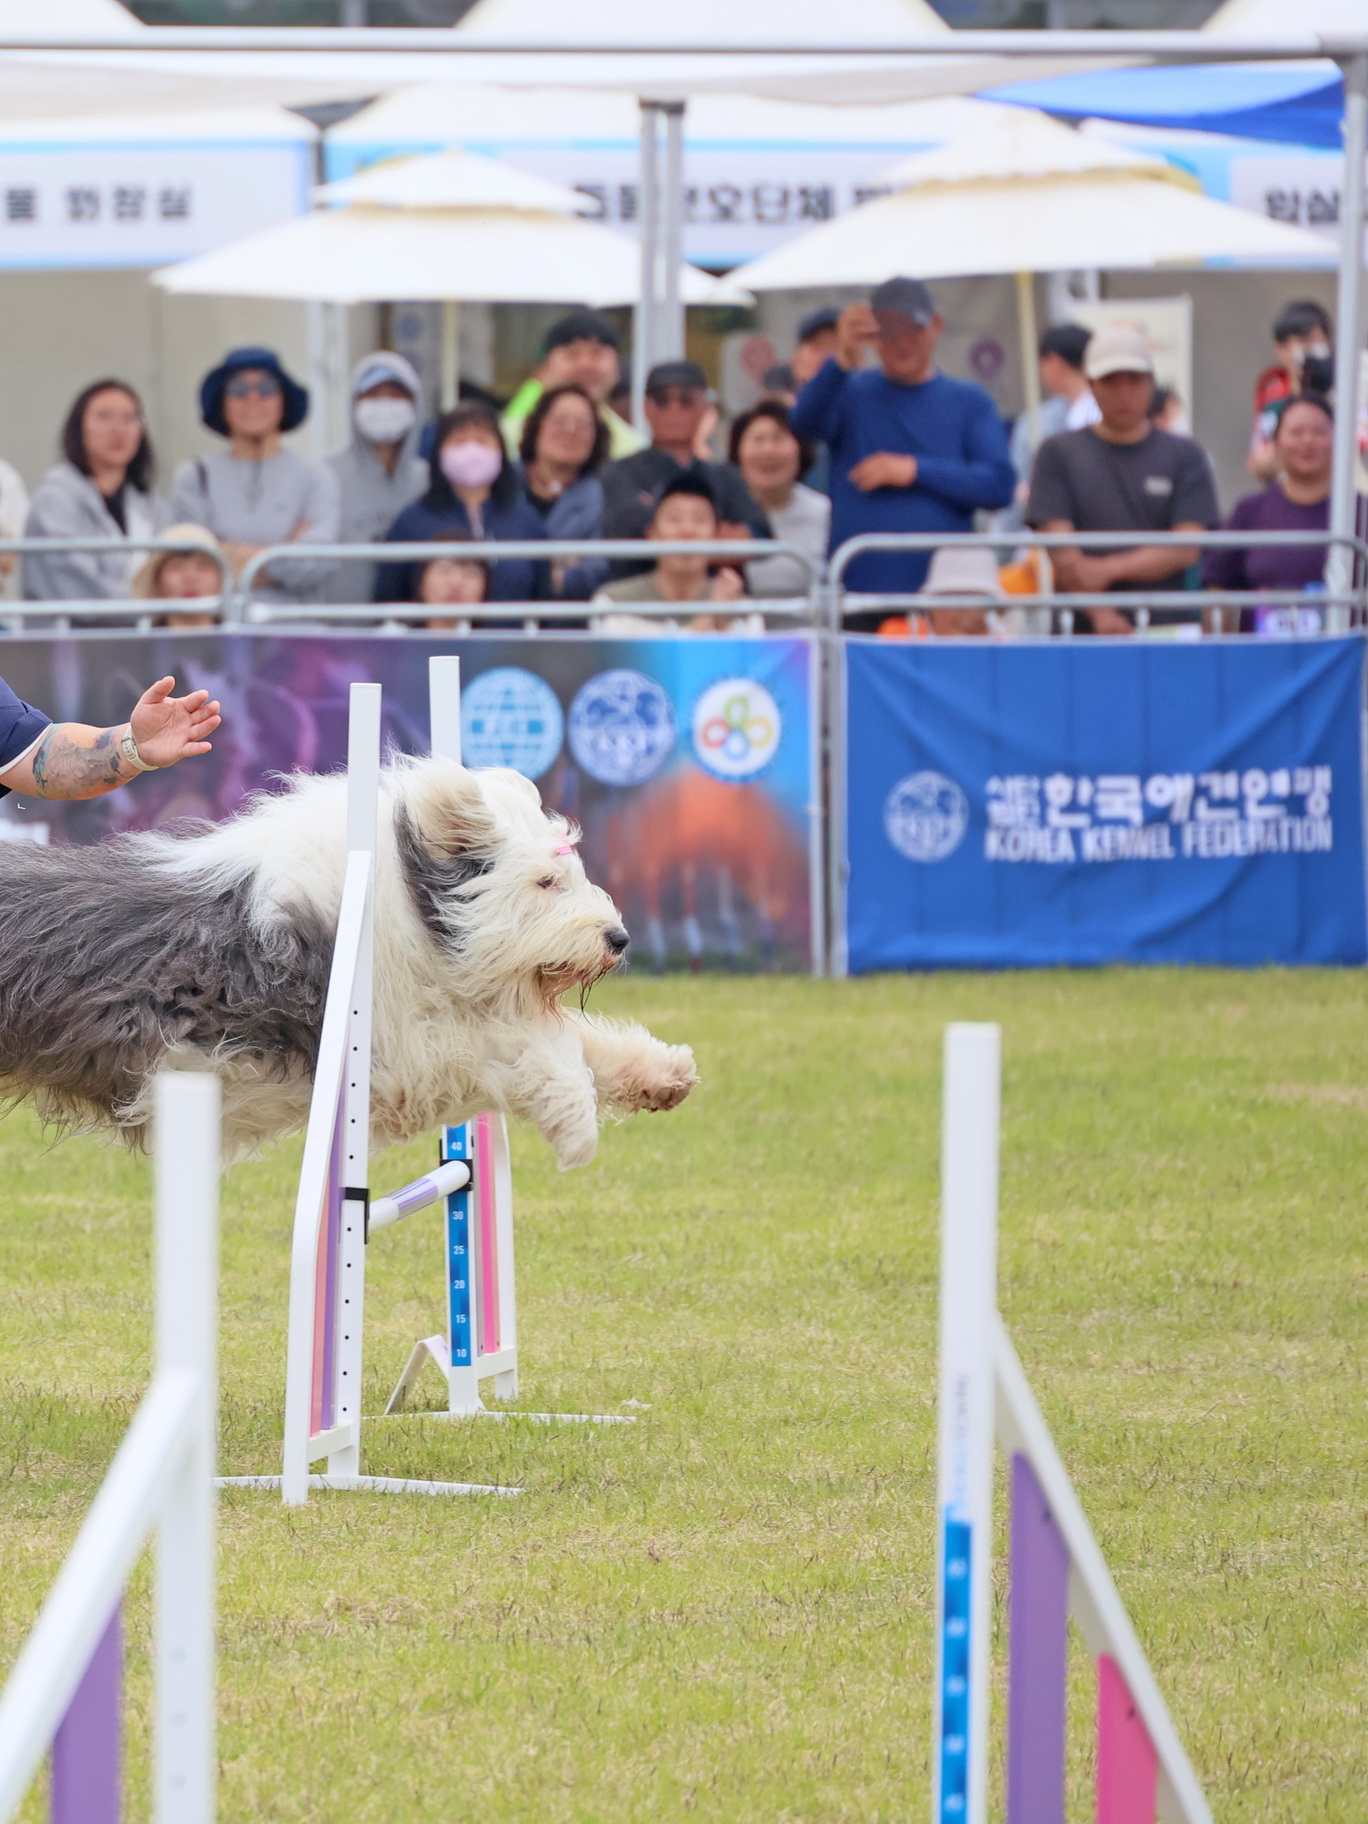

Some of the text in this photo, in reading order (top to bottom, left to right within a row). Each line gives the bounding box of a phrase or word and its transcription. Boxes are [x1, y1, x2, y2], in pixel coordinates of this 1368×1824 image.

[984, 816, 1332, 864] KOREA KENNEL FEDERATION
[451, 1141, 463, 1151] 40
[452, 1210, 464, 1220] 30
[453, 1245, 465, 1255] 25
[454, 1280, 466, 1289] 20
[455, 1314, 467, 1324] 15
[456, 1348, 468, 1358] 10
